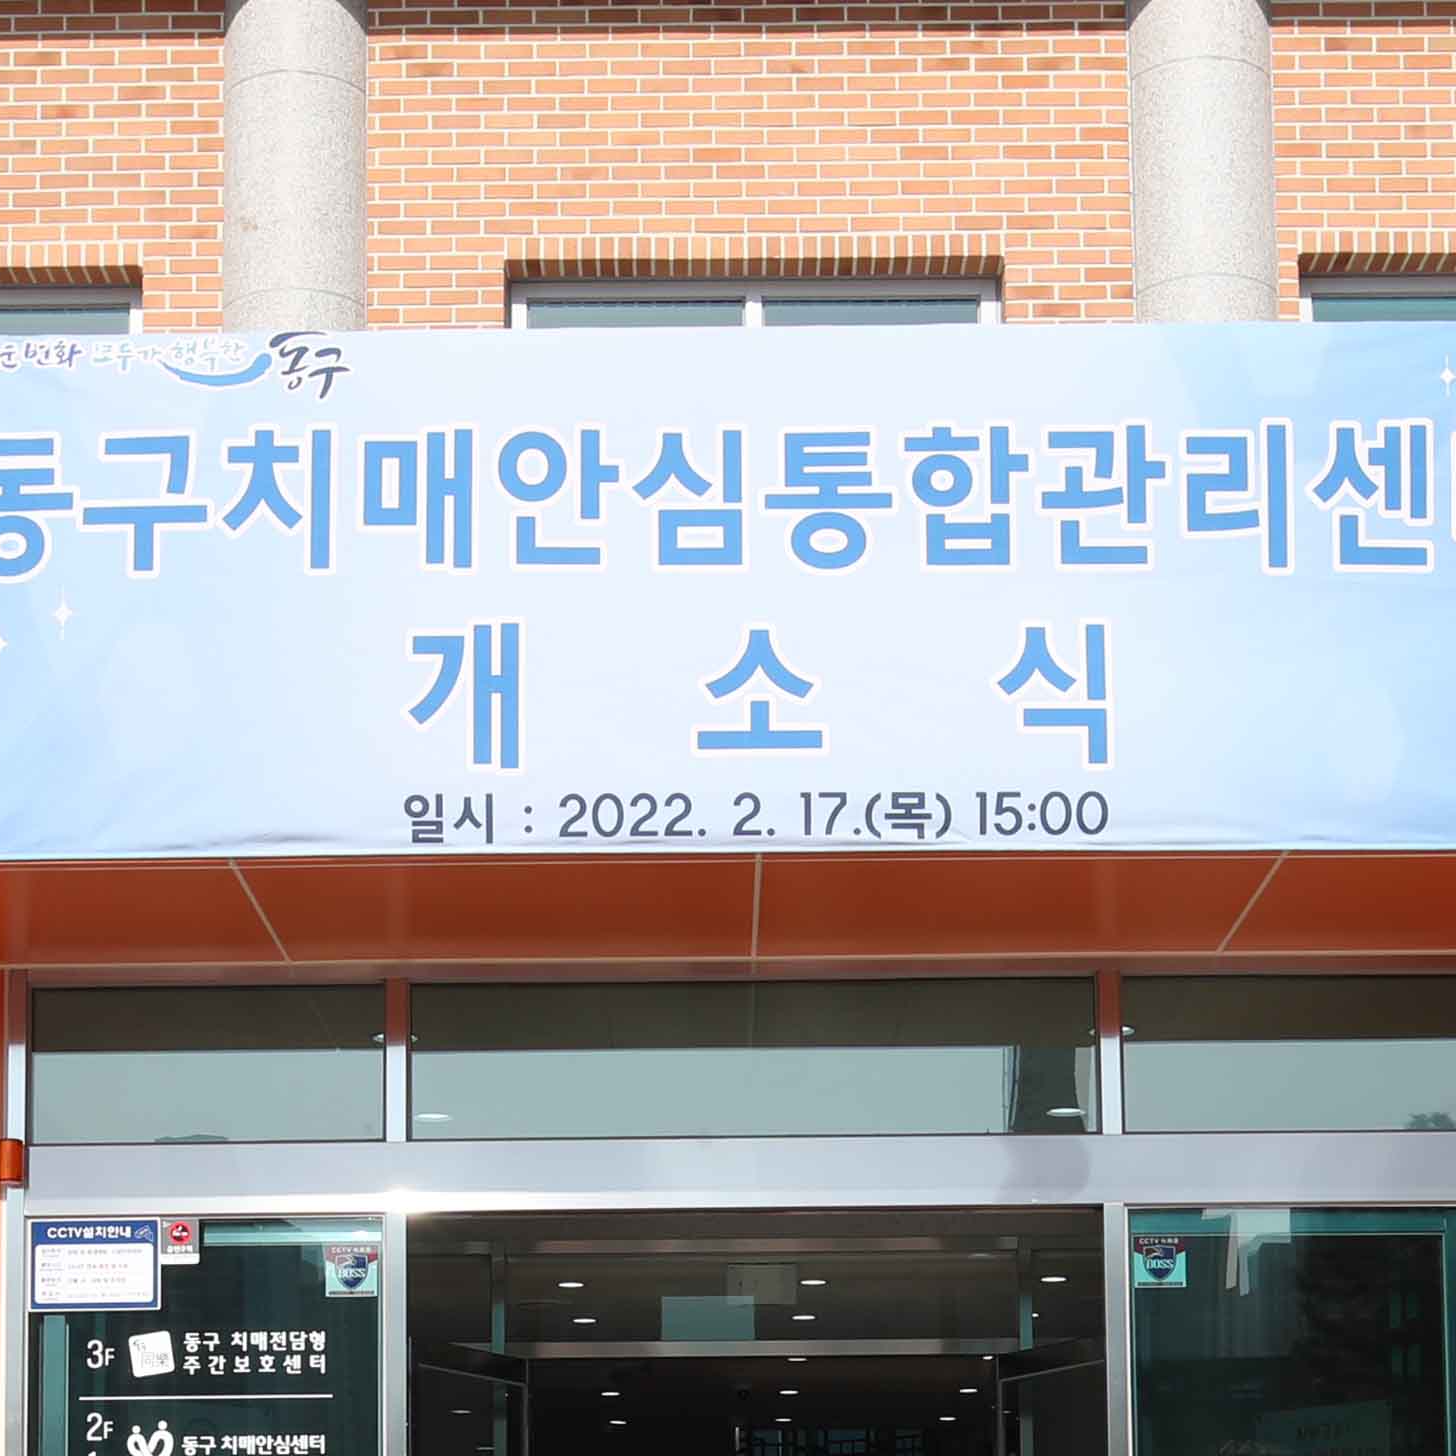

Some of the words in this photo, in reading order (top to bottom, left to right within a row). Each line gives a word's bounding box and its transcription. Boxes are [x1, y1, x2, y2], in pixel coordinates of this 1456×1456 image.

[23, 341, 82, 369] 변화
[169, 340, 245, 372] 행복한
[269, 331, 351, 399] 동구
[404, 793, 495, 844] 일시
[559, 793, 707, 838] 2022.
[732, 793, 775, 837] 2.
[800, 791, 952, 845] 17.(목)
[976, 791, 1109, 836] 15:00
[86, 1339, 115, 1369] 3F
[183, 1332, 221, 1352] 동구
[230, 1331, 326, 1352] 치매전담형
[86, 1412, 114, 1442] 2F
[182, 1435, 217, 1456] 동구
[221, 1434, 326, 1456] 치매안심센터
